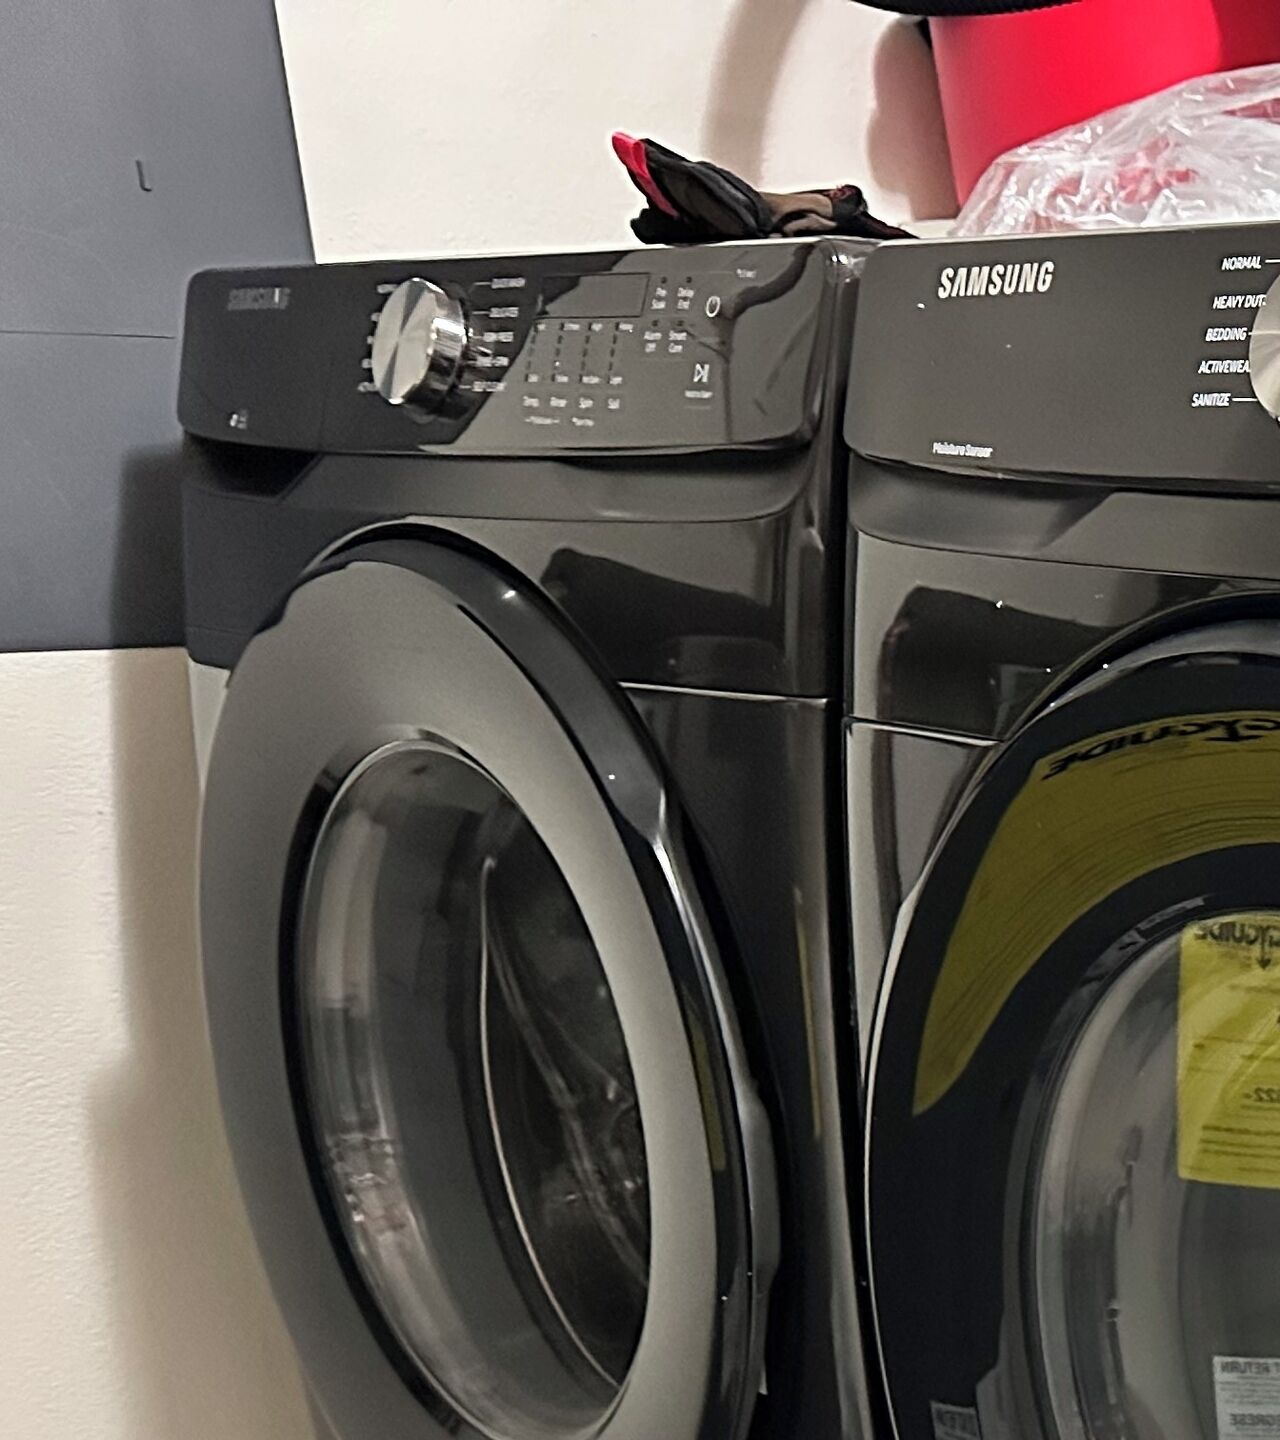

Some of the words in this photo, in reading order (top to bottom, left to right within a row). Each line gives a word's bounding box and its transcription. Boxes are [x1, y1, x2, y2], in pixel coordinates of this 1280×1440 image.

[1221, 256, 1262, 270] NORMAL
[938, 261, 1055, 299] SAMSUNG
[1213, 296, 1244, 309] HEAVY
[1244, 294, 1267, 307] DUT
[1205, 327, 1248, 341] BEDDING
[1198, 360, 1252, 374] ACTIVEWEA
[1191, 393, 1232, 407] SANITIZE
